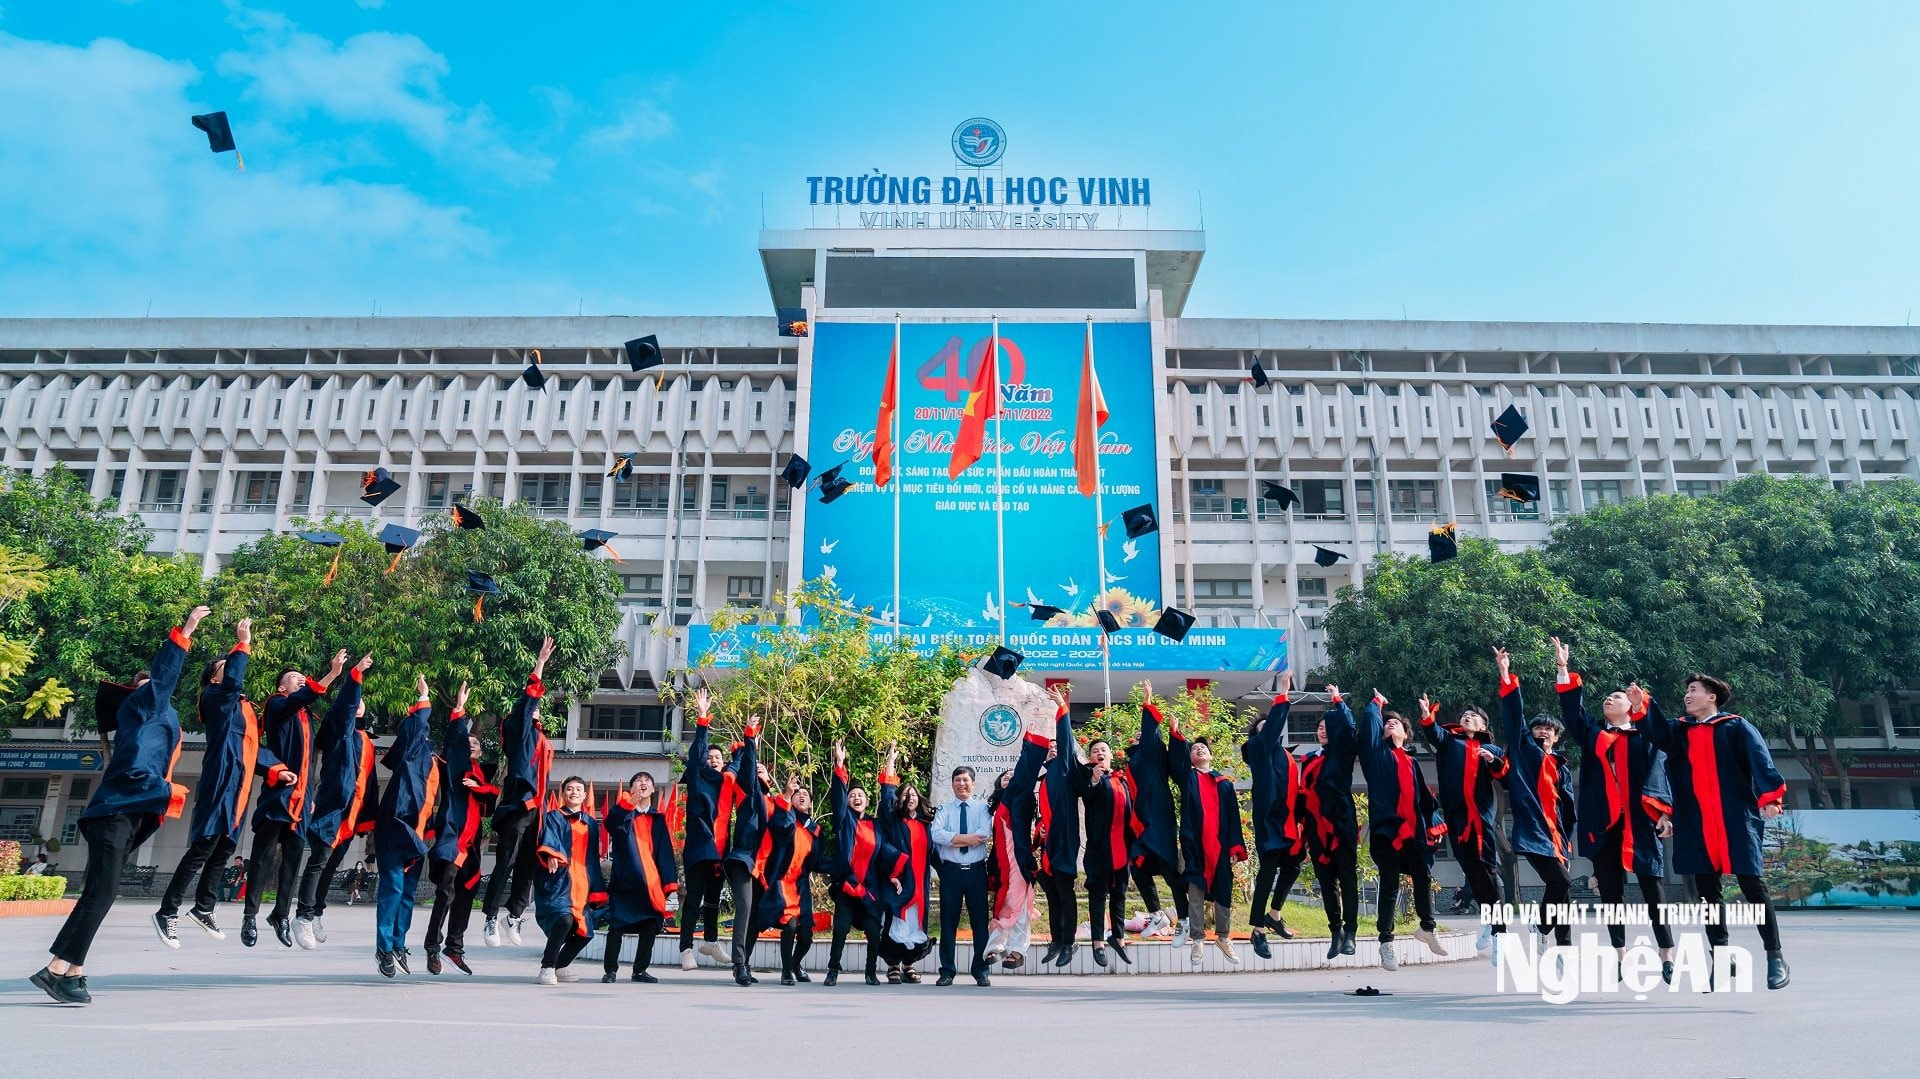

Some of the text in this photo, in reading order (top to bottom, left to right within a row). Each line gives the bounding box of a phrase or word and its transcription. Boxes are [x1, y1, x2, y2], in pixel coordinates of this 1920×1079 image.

[806, 168, 1151, 212] TRƯỜNG ĐẠI HỌC VINH
[860, 211, 1100, 230] VINH UNIVERSITY
[999, 383, 1053, 403] Năm
[914, 407, 1052, 421] 20/11/19 /11/2022
[983, 431, 1015, 454] iáo
[1020, 429, 1066, 459] Việt
[1069, 431, 1133, 455] am
[905, 465, 929, 477] SÁNG
[967, 466, 984, 477] SỨC
[1013, 464, 1031, 477] ĐẤU
[1033, 466, 1058, 478] HOÀN
[1060, 466, 1078, 478] THÀ
[903, 483, 923, 495] MỤC
[925, 482, 945, 494] TIÊU
[946, 481, 962, 494] ĐỔI
[1012, 482, 1025, 494] CỐ
[1026, 483, 1038, 494] VÀ
[1040, 483, 1065, 495] NÂNG
[1067, 484, 1081, 494] CA
[1111, 483, 1141, 497] LƯỢNG
[935, 500, 956, 511] GIÁO
[958, 501, 976, 512] DỤC
[978, 500, 990, 511] VÀ
[1012, 501, 1030, 512] TẠO
[1009, 631, 1048, 646] QUỐC
[1052, 632, 1092, 646] ĐOÀN
[1095, 634, 1133, 646] TNCS
[1137, 632, 1156, 646] HỒ
[1188, 635, 1226, 646] MINH
[1023, 650, 1059, 659] 2022
[1068, 650, 1104, 659] 2027
